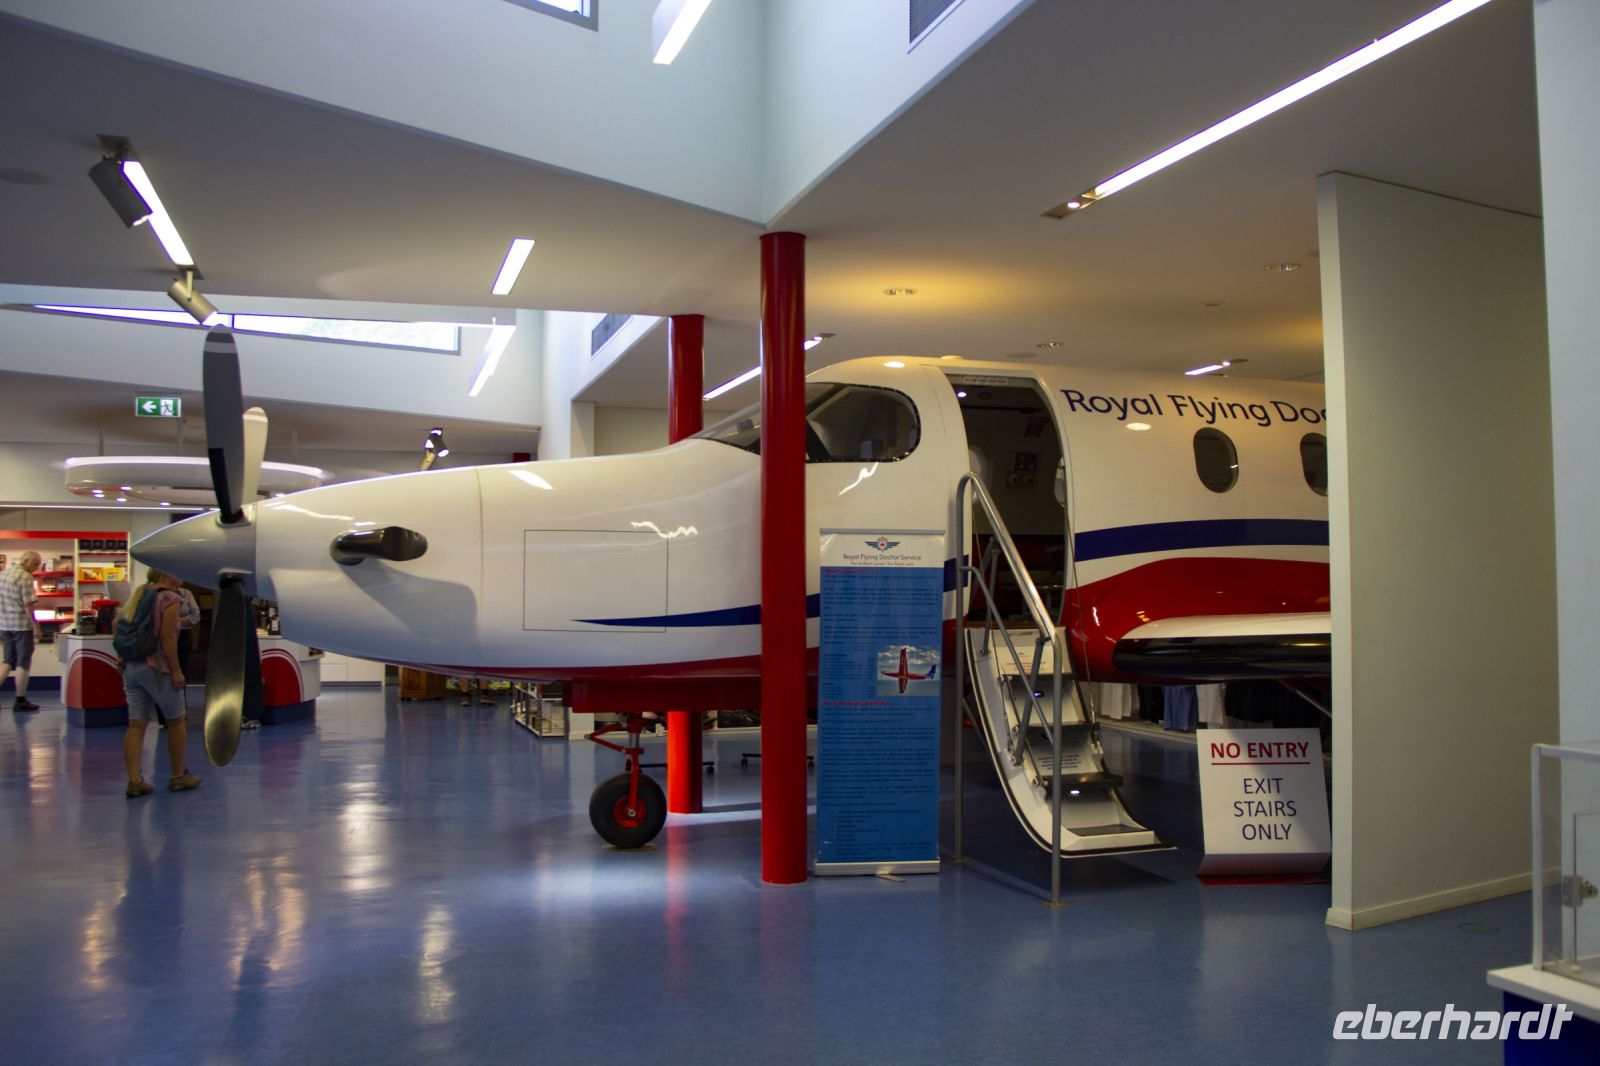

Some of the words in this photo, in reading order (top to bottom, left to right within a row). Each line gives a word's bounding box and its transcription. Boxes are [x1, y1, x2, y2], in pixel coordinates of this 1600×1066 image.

[1060, 389, 1163, 421] Royal
[1167, 394, 1272, 427] Flying
[1270, 400, 1327, 424] Do
[842, 553, 860, 561] Royal
[860, 553, 879, 561] Flying
[879, 553, 899, 561] Doctor
[1210, 742, 1241, 759] NO
[1247, 742, 1309, 759] ENTRY
[1243, 777, 1283, 795] EXIT
[1233, 800, 1297, 817] STAIRS
[1242, 823, 1292, 841] ONLY
